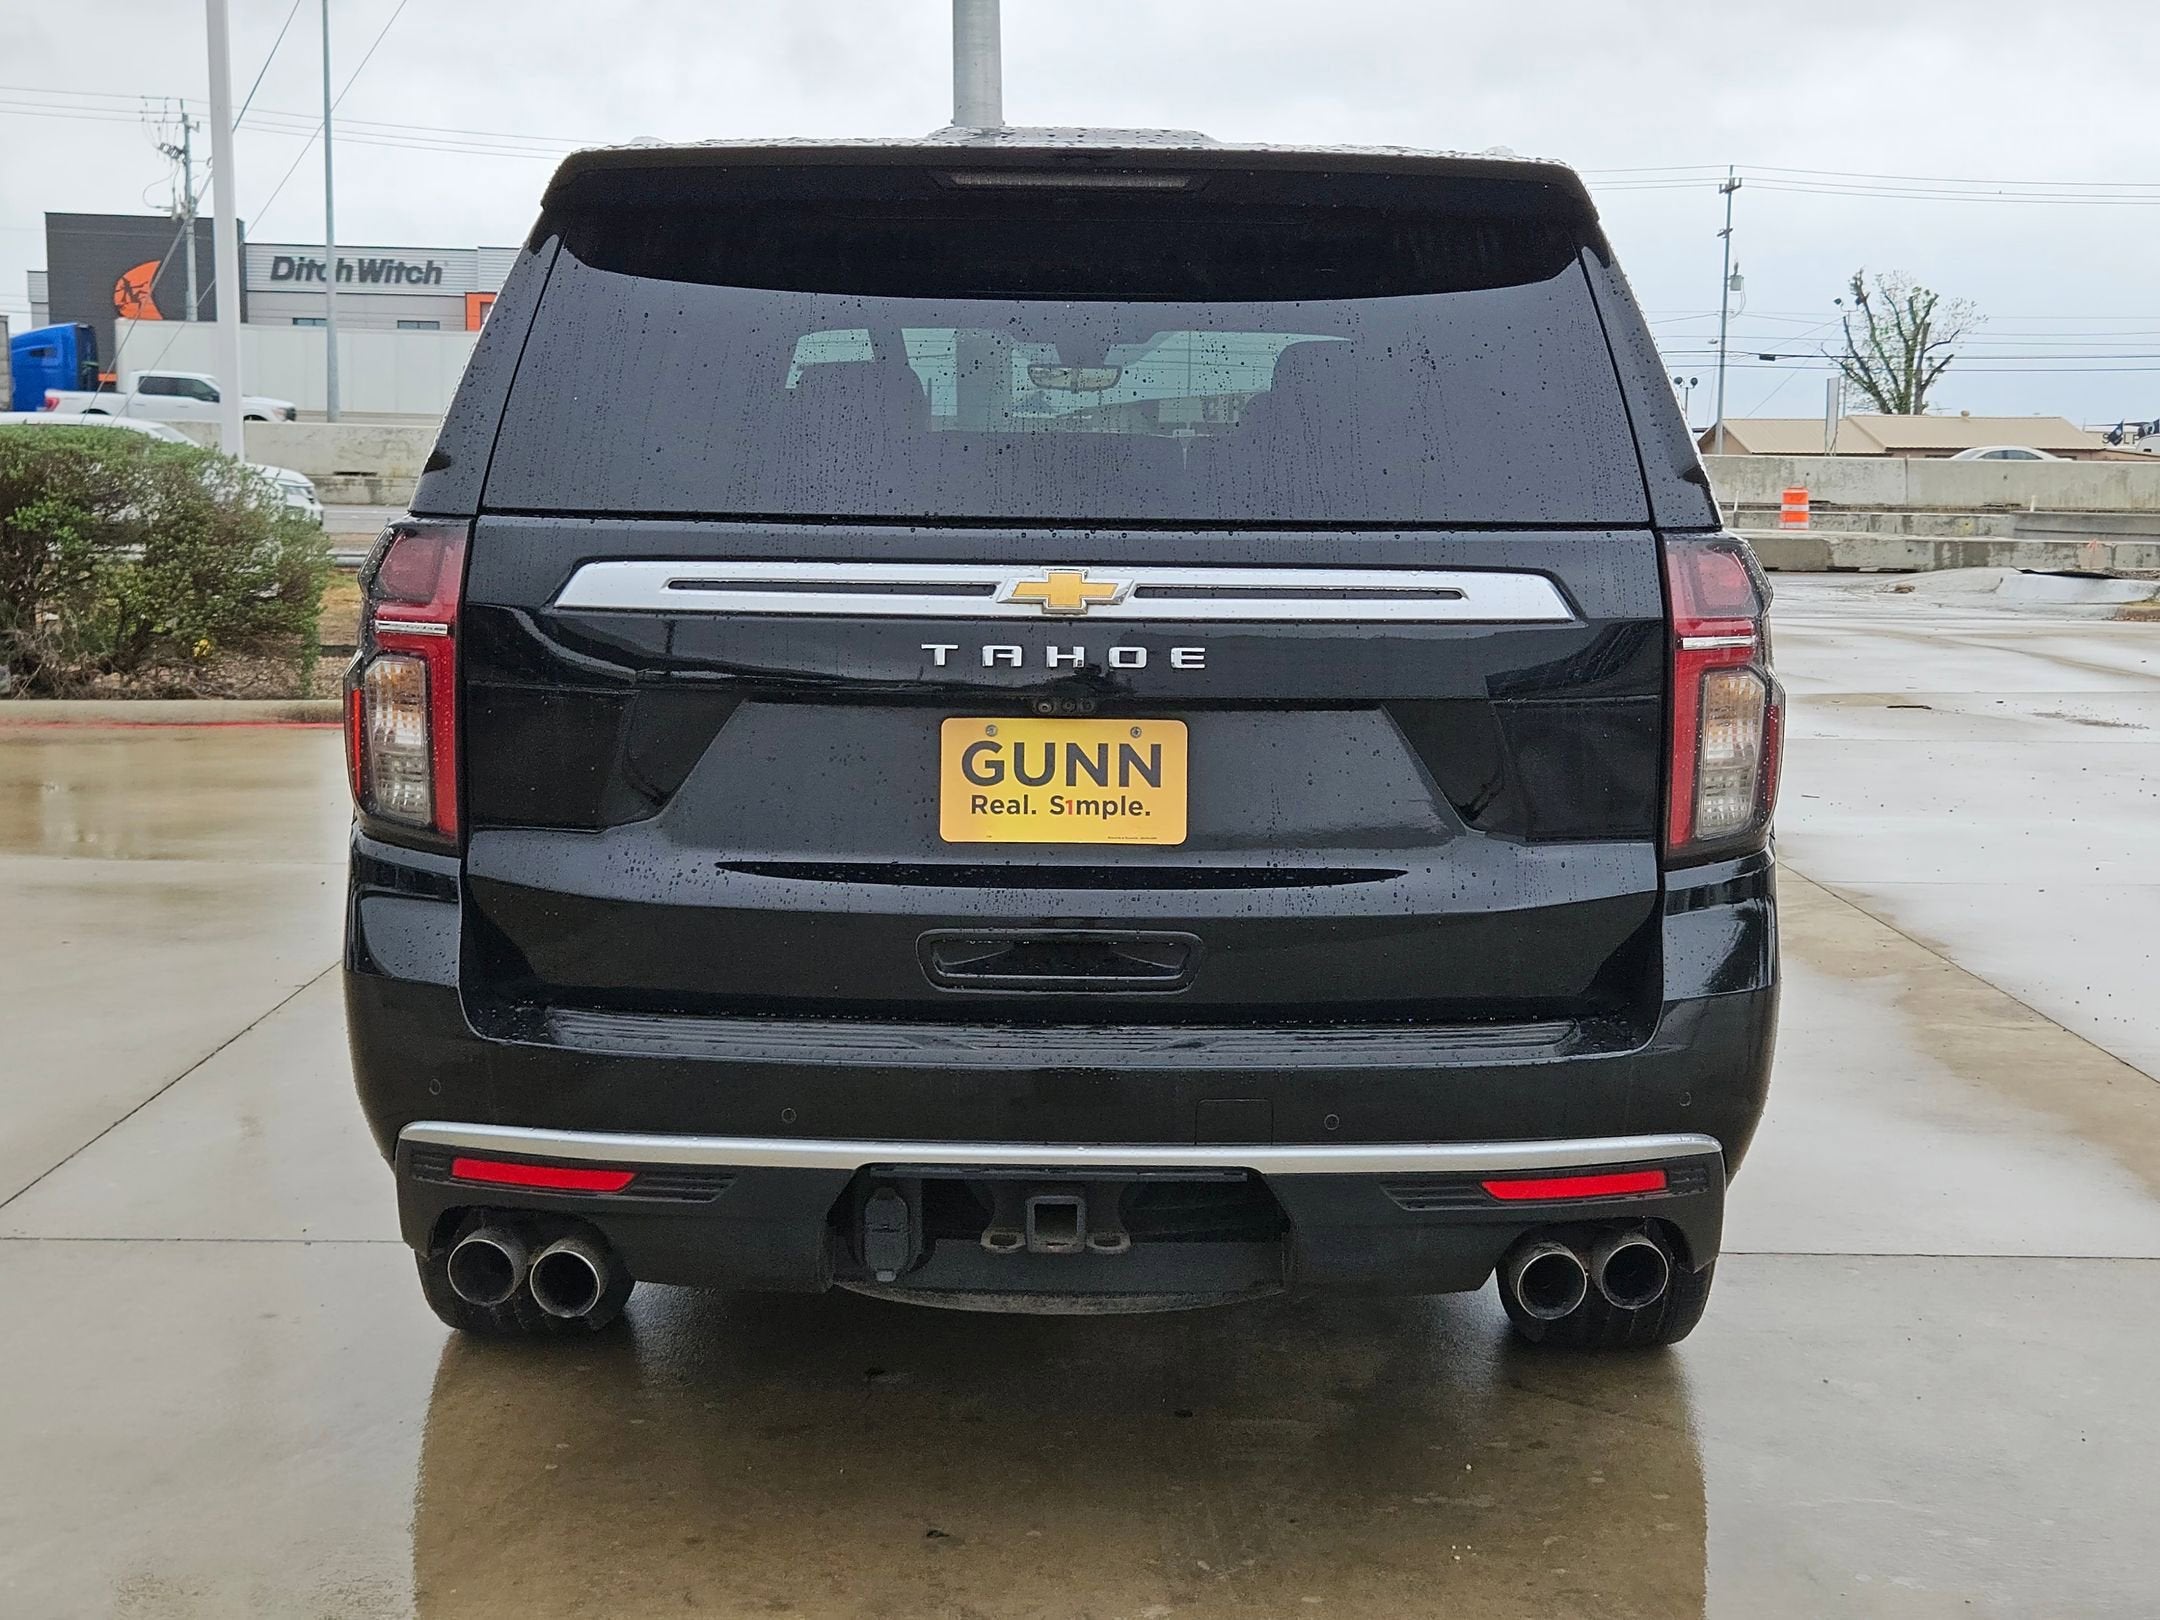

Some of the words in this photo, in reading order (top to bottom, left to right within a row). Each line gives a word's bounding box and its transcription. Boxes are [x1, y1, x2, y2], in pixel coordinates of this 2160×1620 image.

[358, 258, 442, 285] Witch
[921, 643, 1206, 669] TAHOE
[961, 740, 1162, 788] GUNN
[971, 794, 1037, 816] Real.
